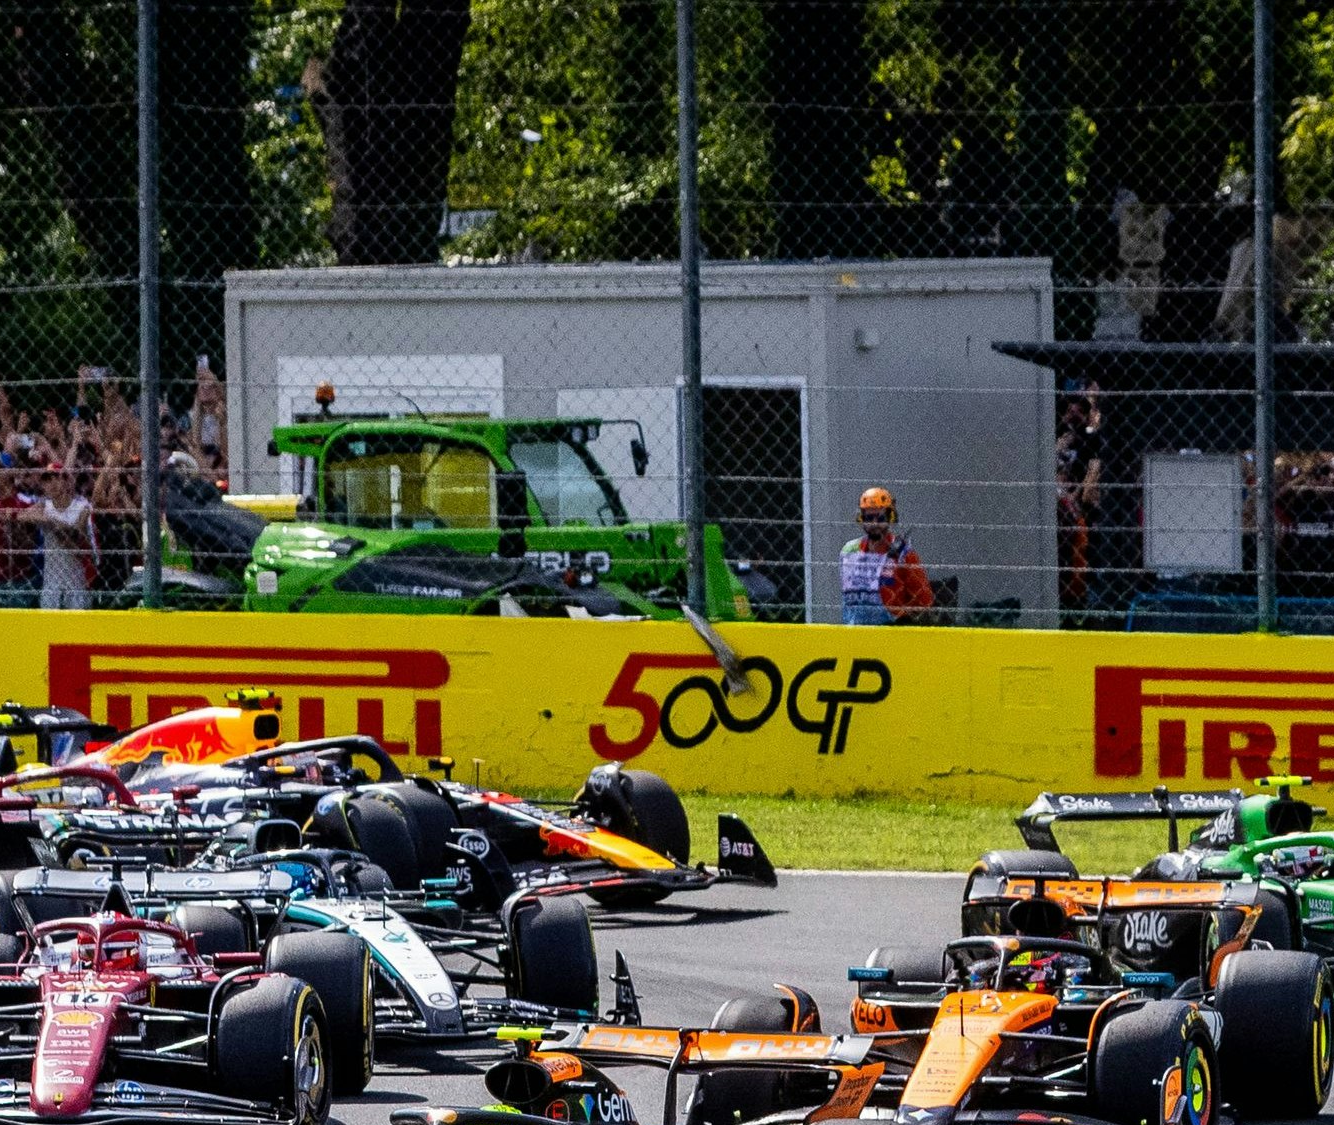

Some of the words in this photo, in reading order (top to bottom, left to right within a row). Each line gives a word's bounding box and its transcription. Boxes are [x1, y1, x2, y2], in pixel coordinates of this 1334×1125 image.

[1058, 795, 1114, 812] Stake
[1179, 793, 1236, 810] Stake
[731, 842, 755, 857] AT&T
